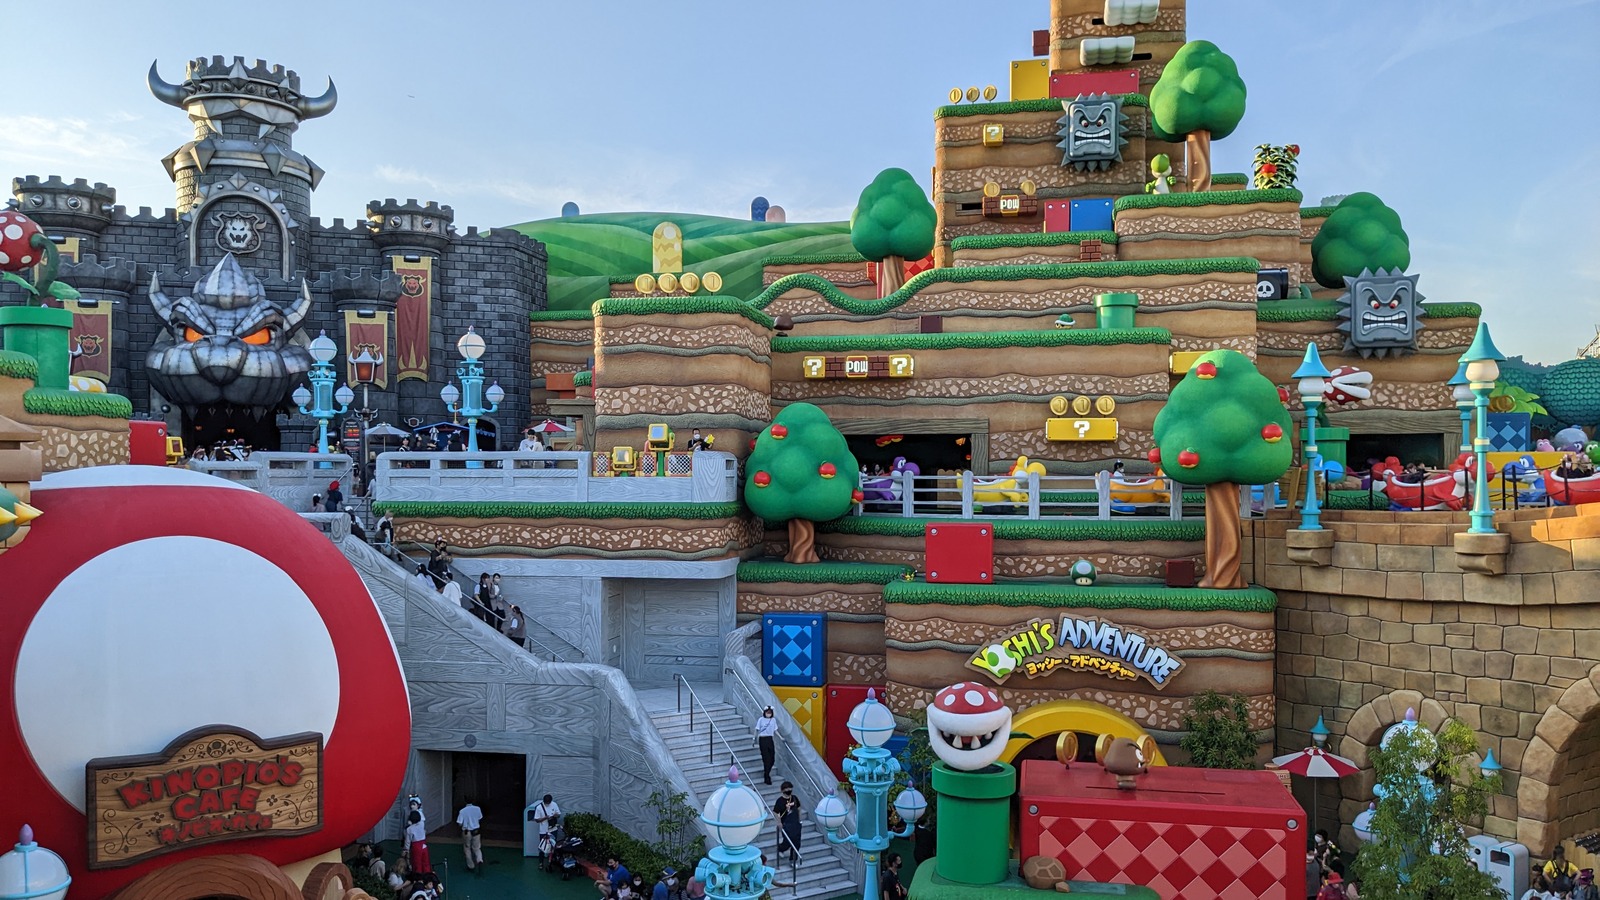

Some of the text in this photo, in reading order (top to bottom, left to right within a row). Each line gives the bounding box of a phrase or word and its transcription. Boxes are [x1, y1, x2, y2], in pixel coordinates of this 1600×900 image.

[1001, 199, 1019, 210] POW
[846, 360, 868, 373] POW
[972, 616, 1182, 685] YOSHI'S ADVENTURE
[118, 754, 304, 809] KINOPIO'S
[171, 785, 261, 820] CAFE
